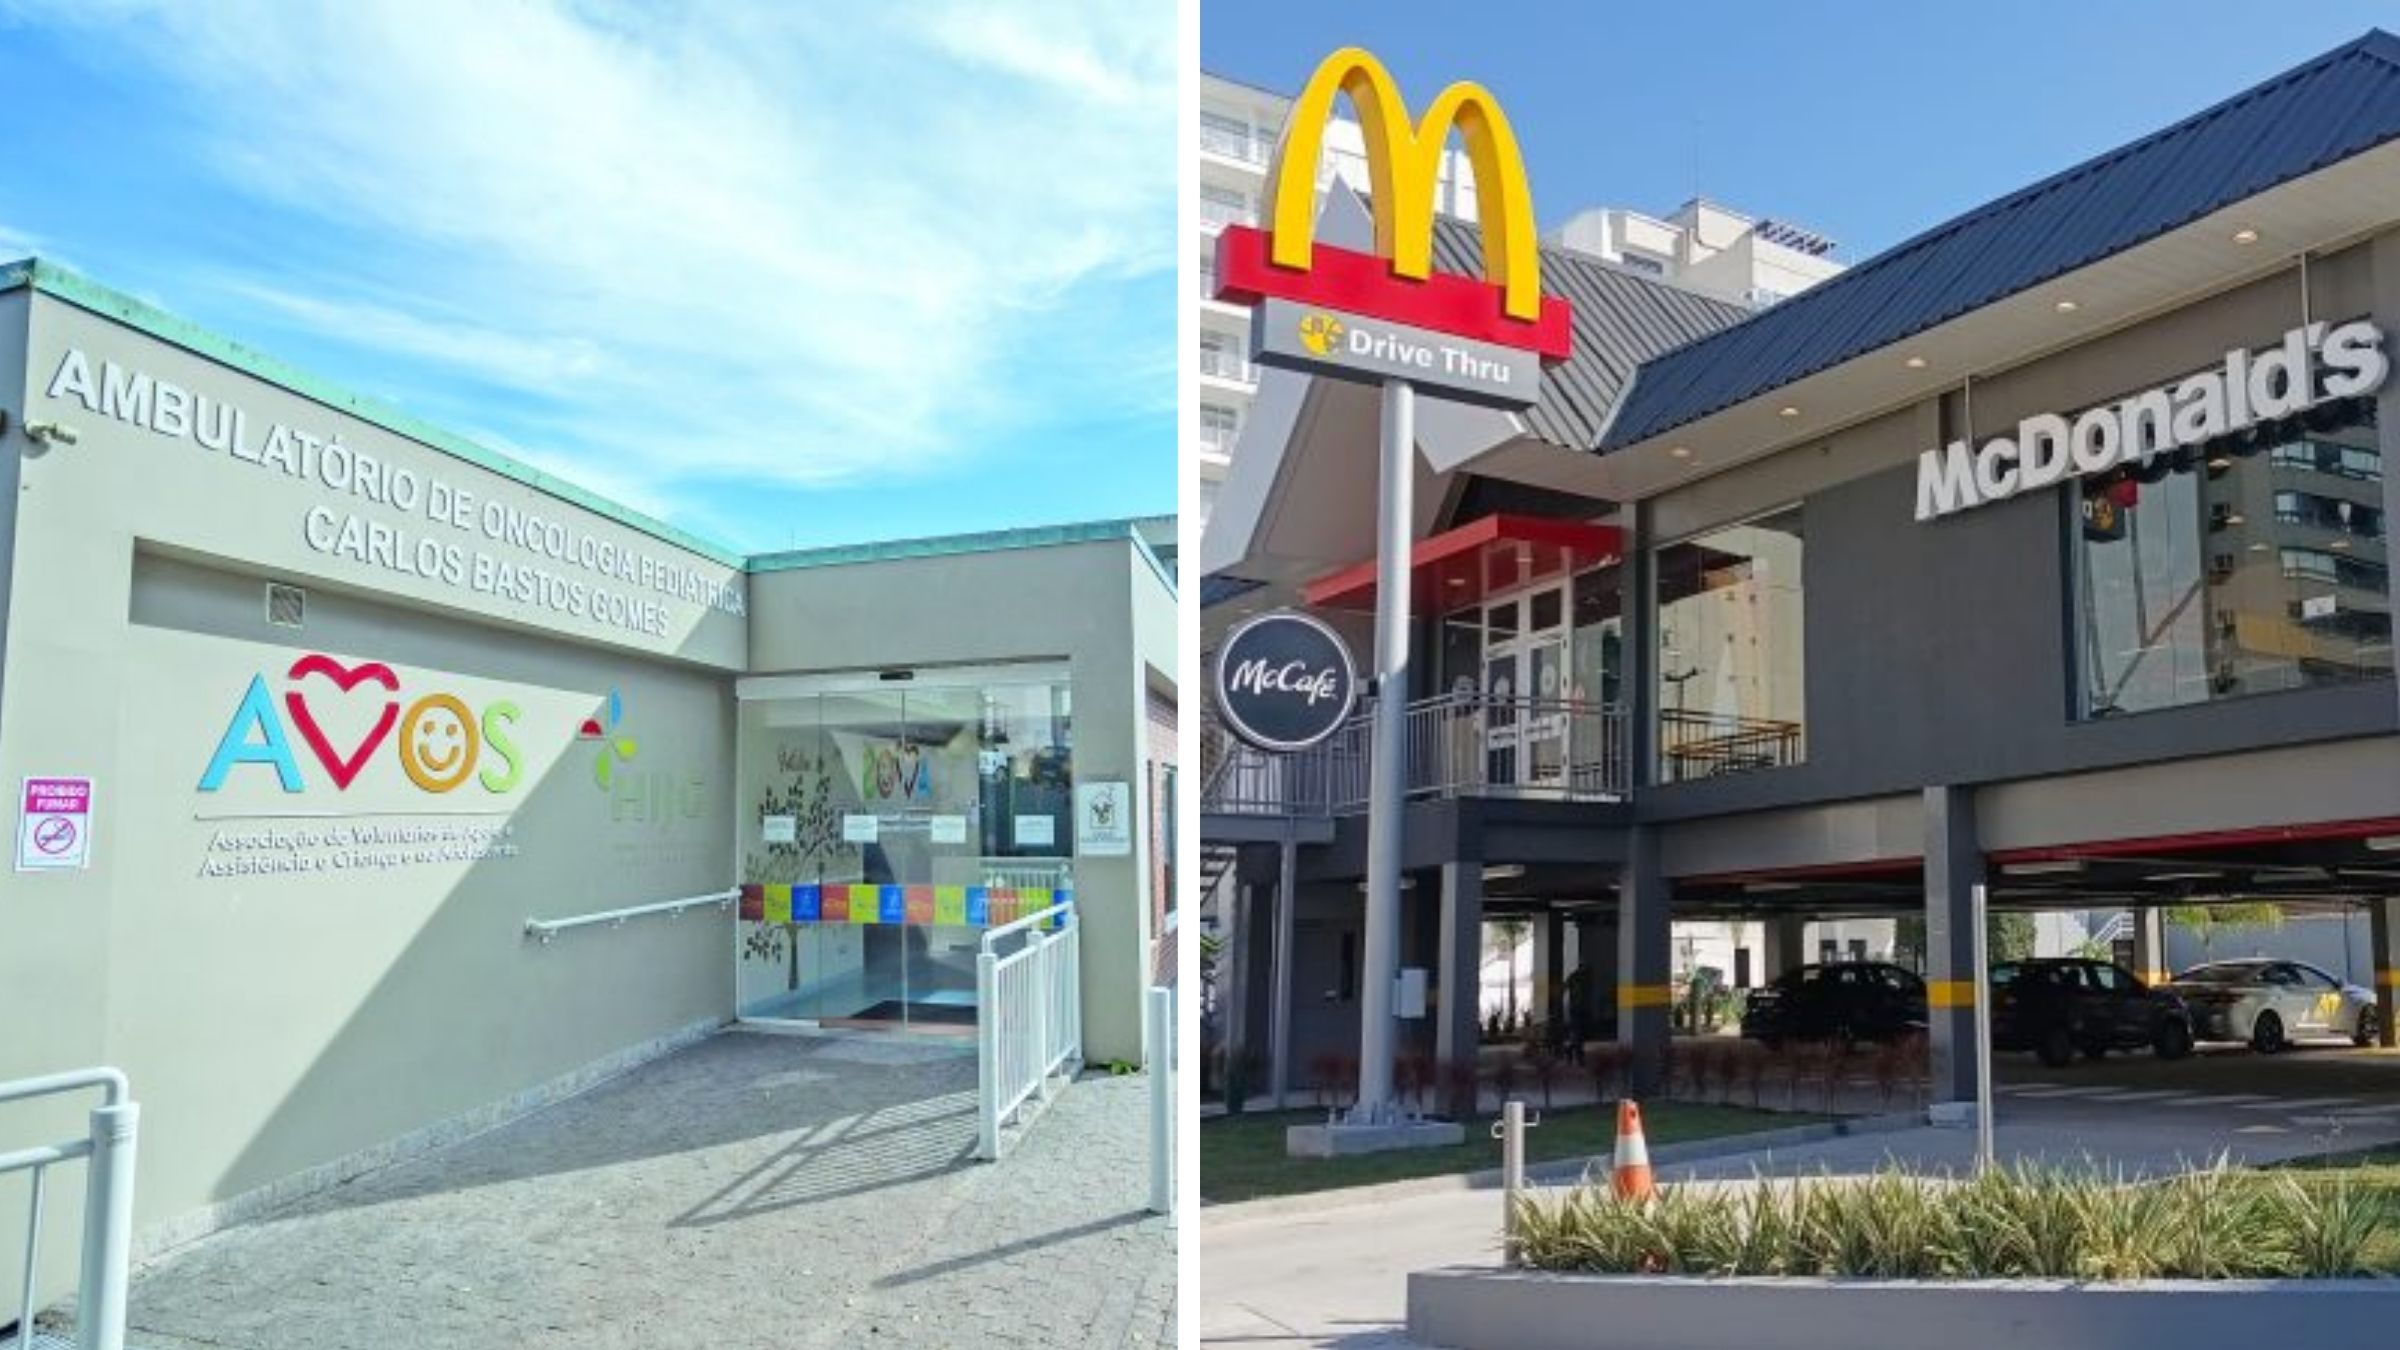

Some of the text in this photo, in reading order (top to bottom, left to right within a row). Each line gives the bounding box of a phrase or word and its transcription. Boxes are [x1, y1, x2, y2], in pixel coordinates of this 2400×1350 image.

[1350, 328, 1510, 384] Drive Thru
[1914, 318, 2390, 522] McDonald's
[46, 349, 418, 512] AMBULATÓRIO
[427, 481, 474, 531] DE
[482, 500, 635, 584] ONCOLOGIA
[305, 504, 669, 640] CARLOS BASTOS GOMES
[197, 654, 525, 793] AVOS
